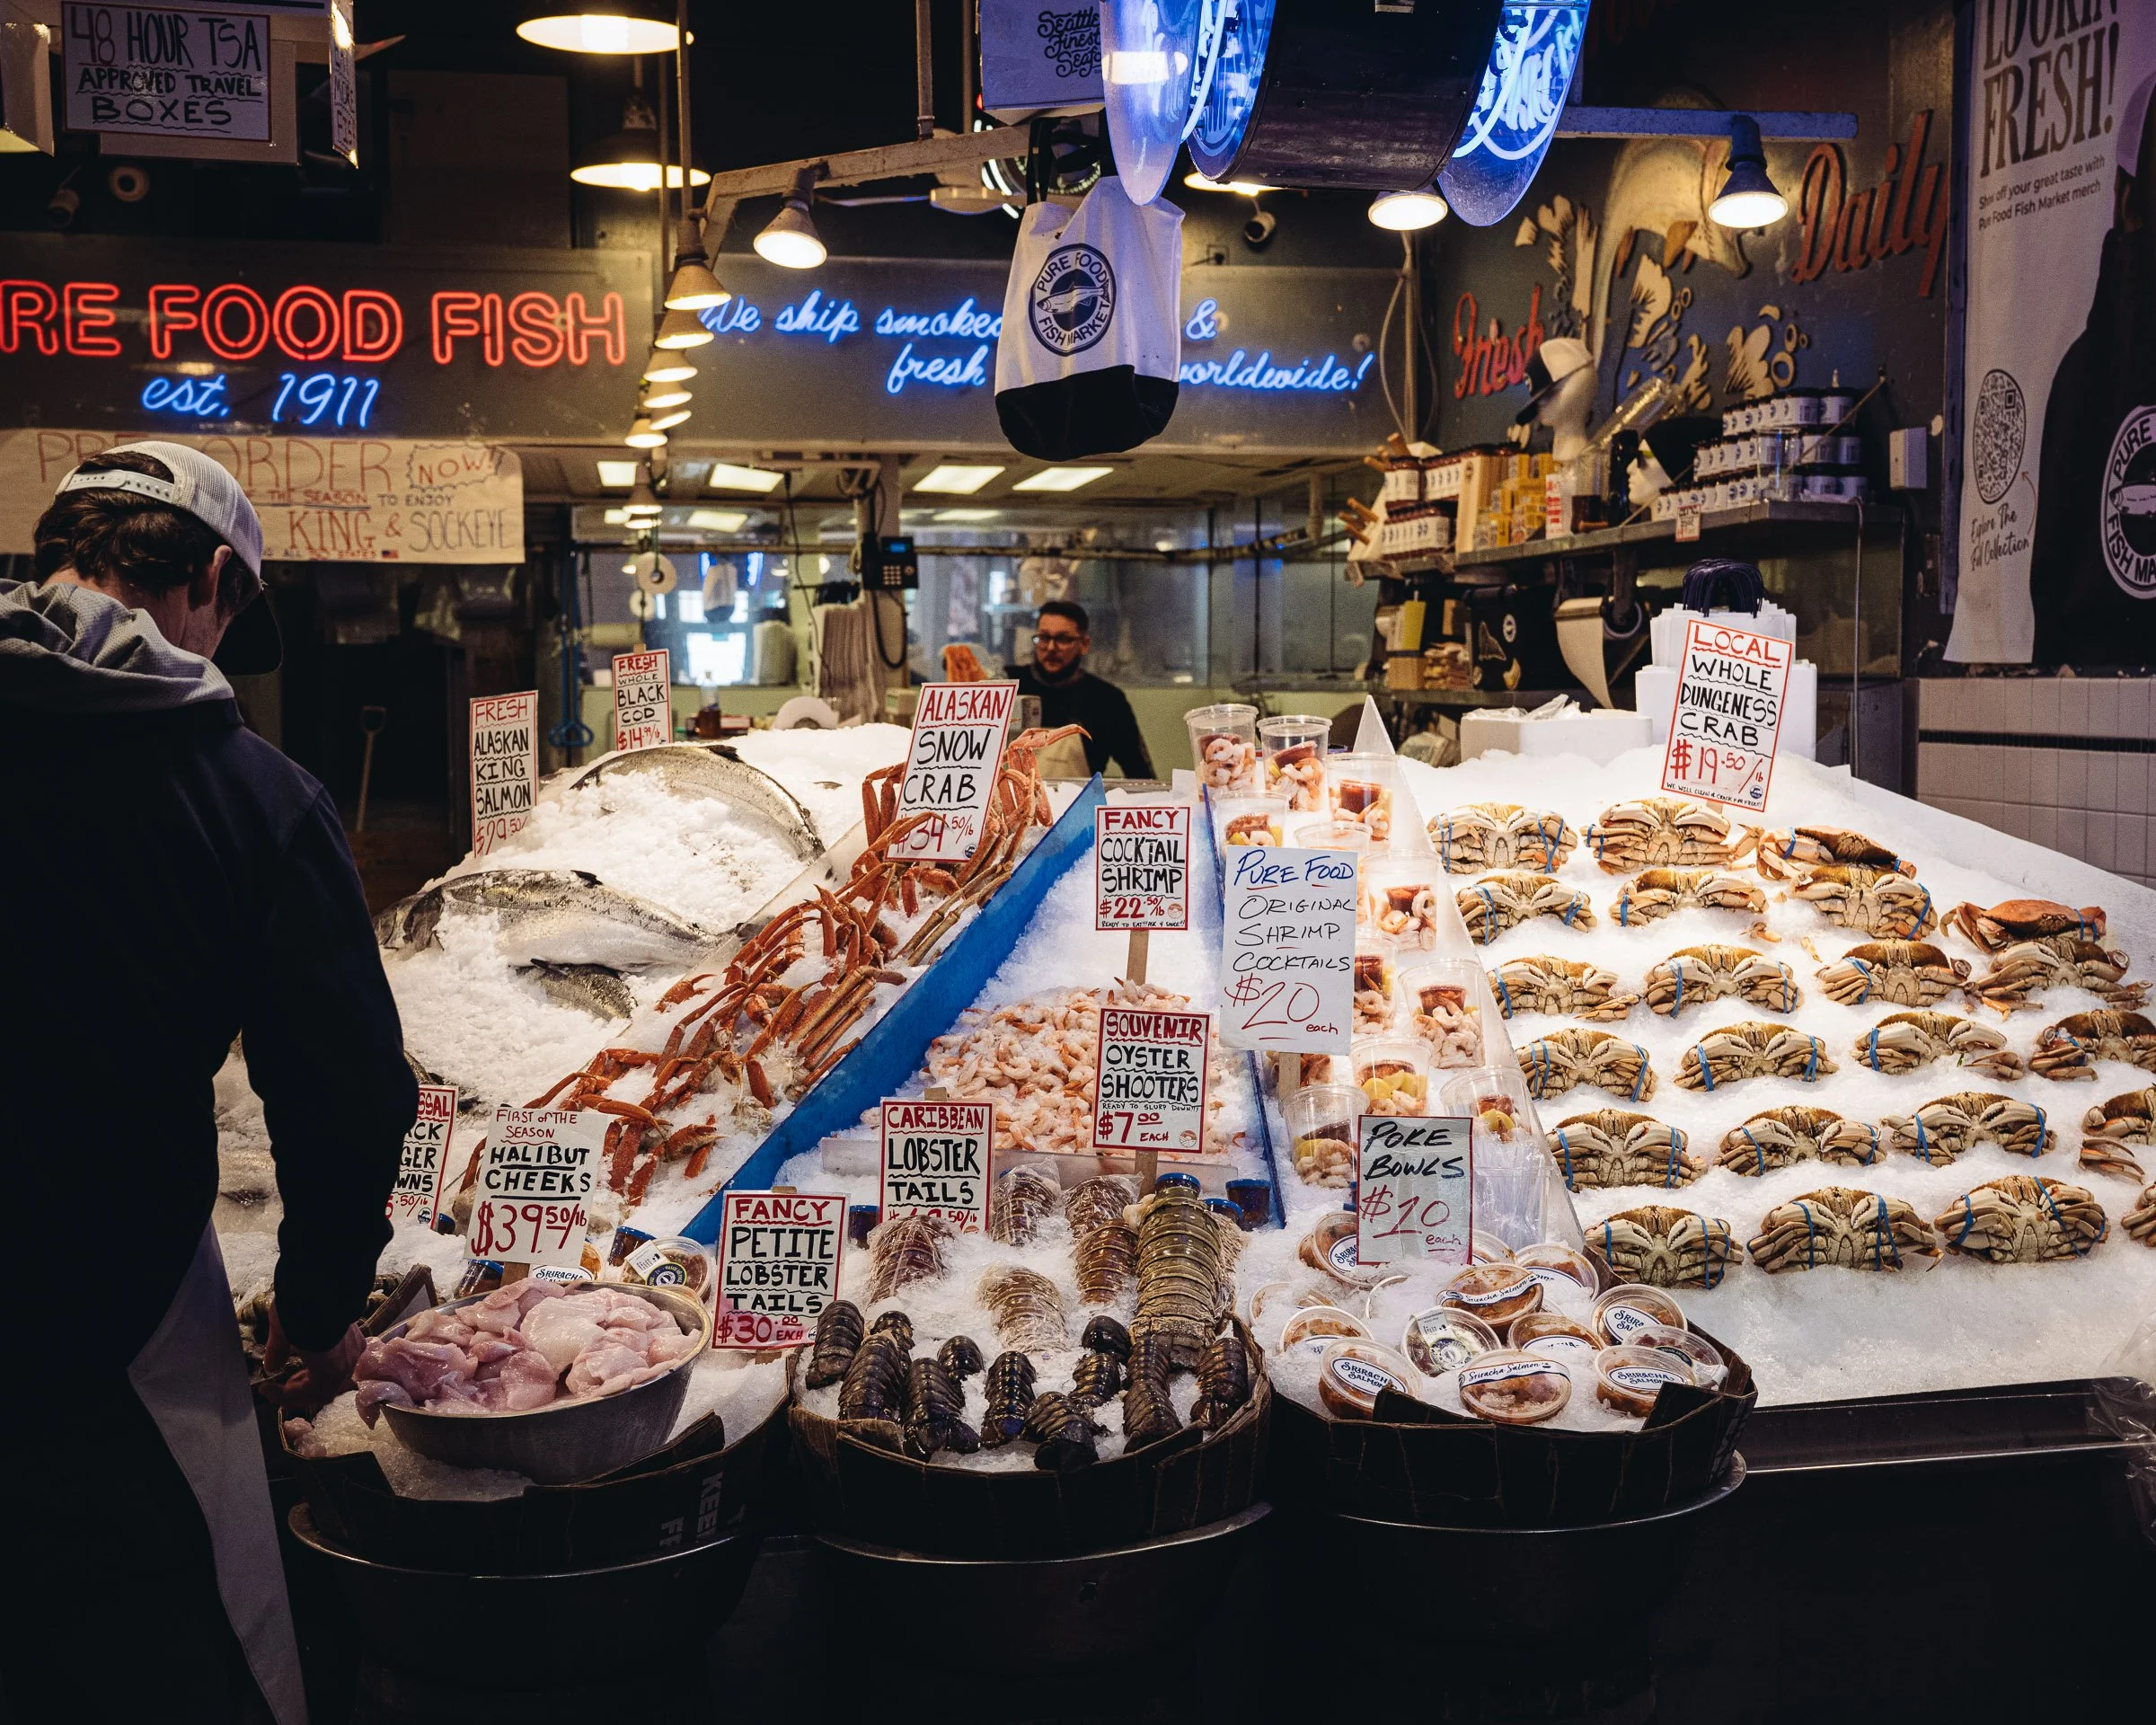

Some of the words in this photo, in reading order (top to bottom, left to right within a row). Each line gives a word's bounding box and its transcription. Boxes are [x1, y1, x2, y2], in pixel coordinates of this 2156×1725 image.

[71, 6, 116, 65] 48
[127, 11, 194, 68] HOUR
[199, 17, 261, 72] TSA
[79, 66, 176, 93] APPROVED
[185, 75, 261, 97] TRAVEL
[92, 95, 232, 126] BOXES
[1980, 22, 2119, 179] FRESH!
[2009, 181, 2031, 200] your
[2034, 172, 2059, 194] great
[2060, 164, 2083, 181] taste
[2085, 155, 2105, 173] with
[1791, 109, 1949, 298] Daily
[1993, 205, 2012, 224] Food
[2015, 199, 2037, 217] Fish
[2037, 190, 2071, 211] Market
[2072, 178, 2102, 201] merch
[1037, 255, 1072, 293] PURE
[1074, 252, 1109, 285] FOOD
[148, 283, 403, 363] FOOD
[431, 290, 626, 368] FISH
[698, 296, 761, 334] We
[775, 289, 860, 344] ship
[1185, 297, 1218, 340] &
[1038, 316, 1068, 347] FISH
[1453, 284, 1545, 399] Fresh
[887, 341, 989, 395] fresh
[140, 373, 231, 419] est.
[271, 373, 381, 429] 1911
[2113, 418, 2152, 481] PURE
[415, 447, 499, 485] NOW!
[377, 493, 399, 507] TO
[404, 493, 456, 509] ENJOY
[288, 509, 377, 551] KING
[384, 512, 403, 538] &
[408, 508, 516, 553] SOCKEYE
[1998, 503, 2018, 529] The
[1984, 531, 2029, 565] Collection
[2107, 513, 2134, 575] FISH
[1694, 625, 1780, 662] LOCAL
[618, 656, 658, 673] FRESH
[1692, 654, 1772, 691] WHOLE
[618, 673, 658, 686] WHOLE
[618, 685, 665, 708] BLACK
[921, 689, 1010, 722] ALASKAN
[1680, 682, 1777, 727] DUNGENESS
[475, 699, 528, 726] FRESH
[622, 707, 655, 723] COD
[474, 727, 529, 756] ALASKAN
[1680, 712, 1759, 747] CRAB
[916, 729, 992, 765] SNOW
[475, 756, 526, 782] KING
[475, 782, 532, 815] SALMON
[903, 774, 976, 805] CRAB
[1104, 809, 1180, 830] FANCY
[1100, 837, 1185, 865] COCKTAIL
[1101, 867, 1182, 894] SHRIMP
[1233, 848, 1299, 887] PURE
[1304, 855, 1355, 881] FOOD
[1238, 895, 1356, 920] ORIGINAL
[1234, 923, 1340, 946] SHRIMP
[1233, 952, 1351, 972] COCKTAILS
[1224, 973, 1320, 1030] $20
[1106, 1012, 1203, 1044] SOUVENIR
[1305, 1022, 1339, 1035] each
[1106, 1044, 1190, 1069] OYSTER
[1101, 1074, 1198, 1103] SHOOTERS
[496, 1109, 534, 1123] FIRST
[888, 1106, 984, 1130] CARIBBEAN
[505, 1126, 555, 1138] SEASON
[1140, 1131, 1169, 1142] EACH
[1364, 1121, 1452, 1153] POKE
[490, 1146, 590, 1165] HALIBUT
[888, 1137, 980, 1175] LOBSTER
[1364, 1154, 1465, 1181] BOWLS
[485, 1170, 592, 1194] CHEEKS
[888, 1181, 974, 1205] TAILS
[736, 1199, 830, 1221] FANCY
[731, 1226, 835, 1259] PETITE
[1426, 1234, 1462, 1245] each
[727, 1264, 828, 1290] LOBSTER
[1499, 1279, 1527, 1296] Salmon
[727, 1294, 823, 1314] TAILS
[776, 1330, 803, 1341] EACH
[1341, 1361, 1390, 1384] SRIRACH
[1469, 1367, 1505, 1381] Sriracha
[1507, 1362, 1540, 1374] Salmon
